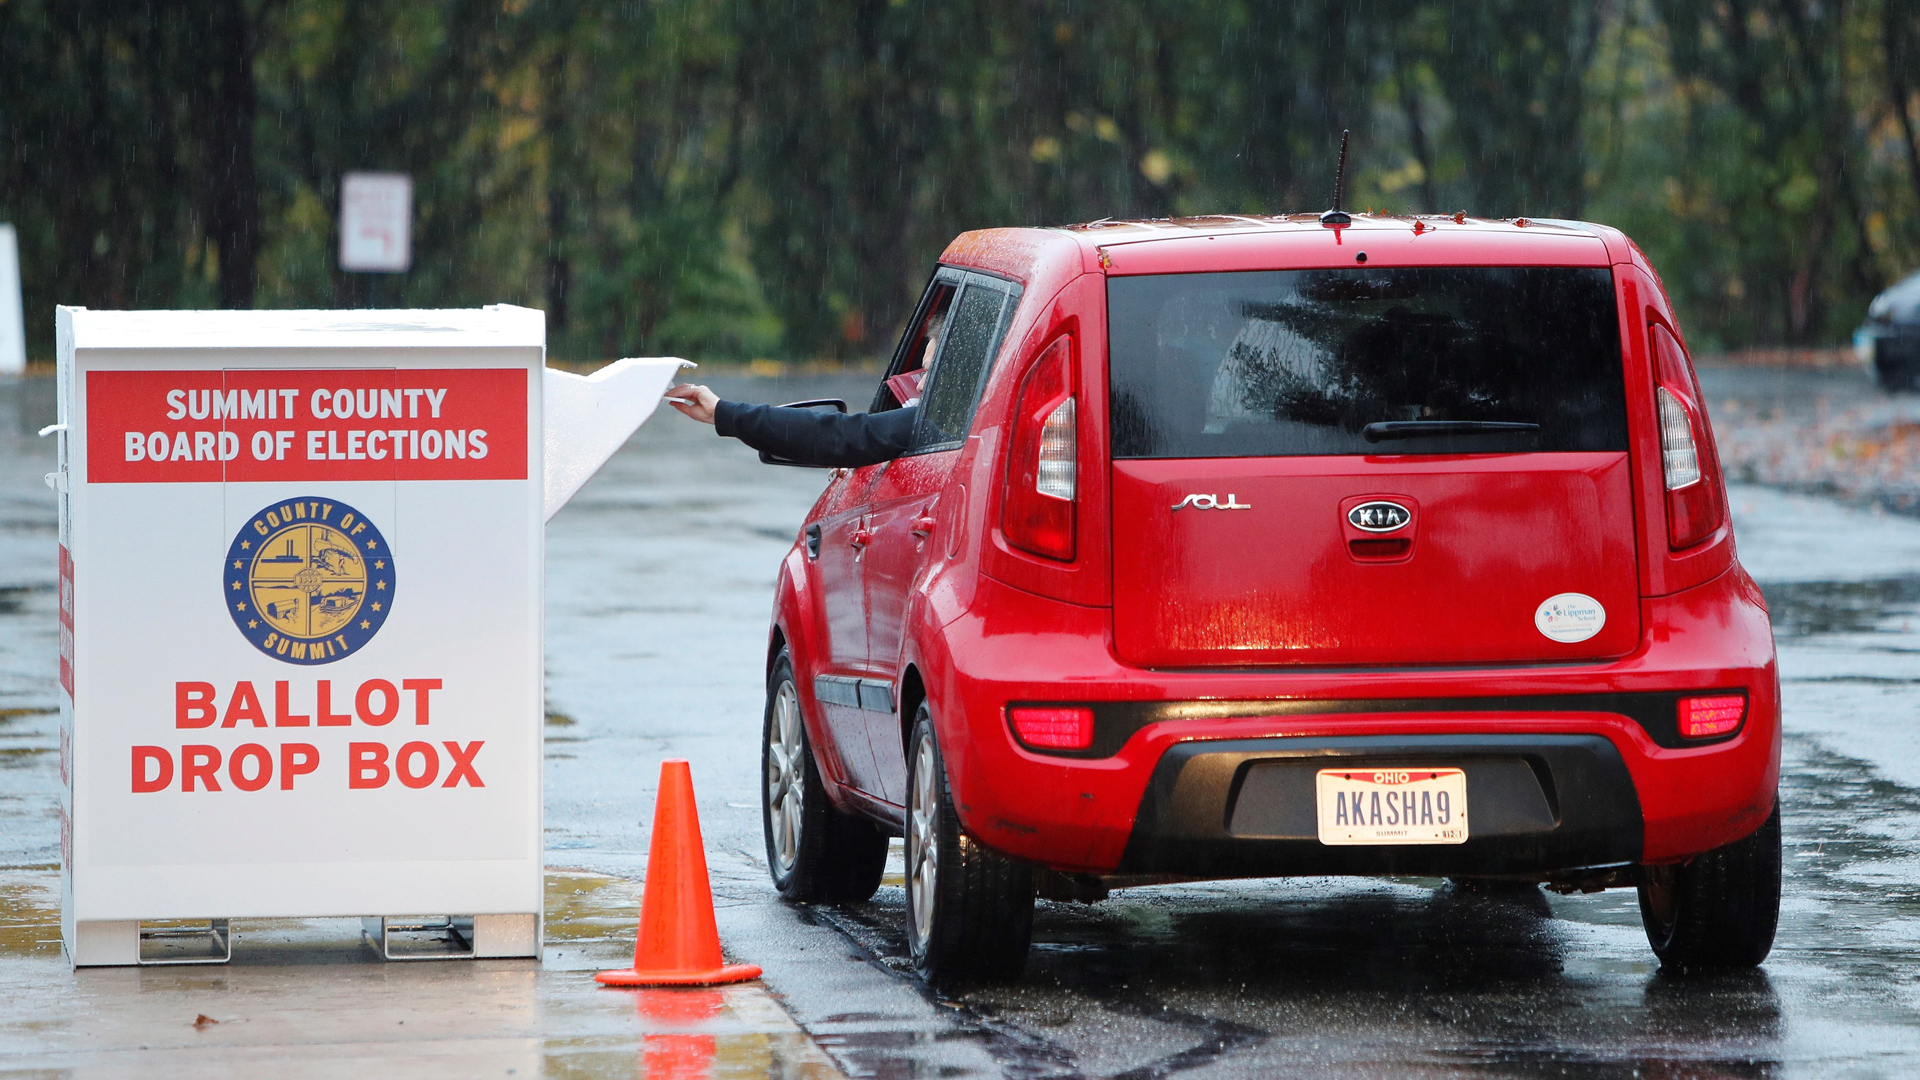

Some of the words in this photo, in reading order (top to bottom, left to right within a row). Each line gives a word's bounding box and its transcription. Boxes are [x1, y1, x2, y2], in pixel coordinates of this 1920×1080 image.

[166, 388, 299, 421] SUMMIT
[311, 388, 447, 419] COUNTY
[125, 431, 239, 462] BOARD
[252, 430, 294, 461] OF
[307, 429, 488, 461] ELECTIONS
[253, 502, 333, 536] COUNTY
[339, 513, 366, 536] OF
[1359, 508, 1401, 526] KIA
[1563, 609, 1596, 618] Lippman
[263, 632, 349, 660] SUMMIT
[175, 678, 442, 729] BALLOT
[131, 743, 320, 793] DROP
[349, 741, 486, 790] BOX
[1374, 772, 1410, 784] OHIO
[1336, 790, 1451, 826] AKASHA9
